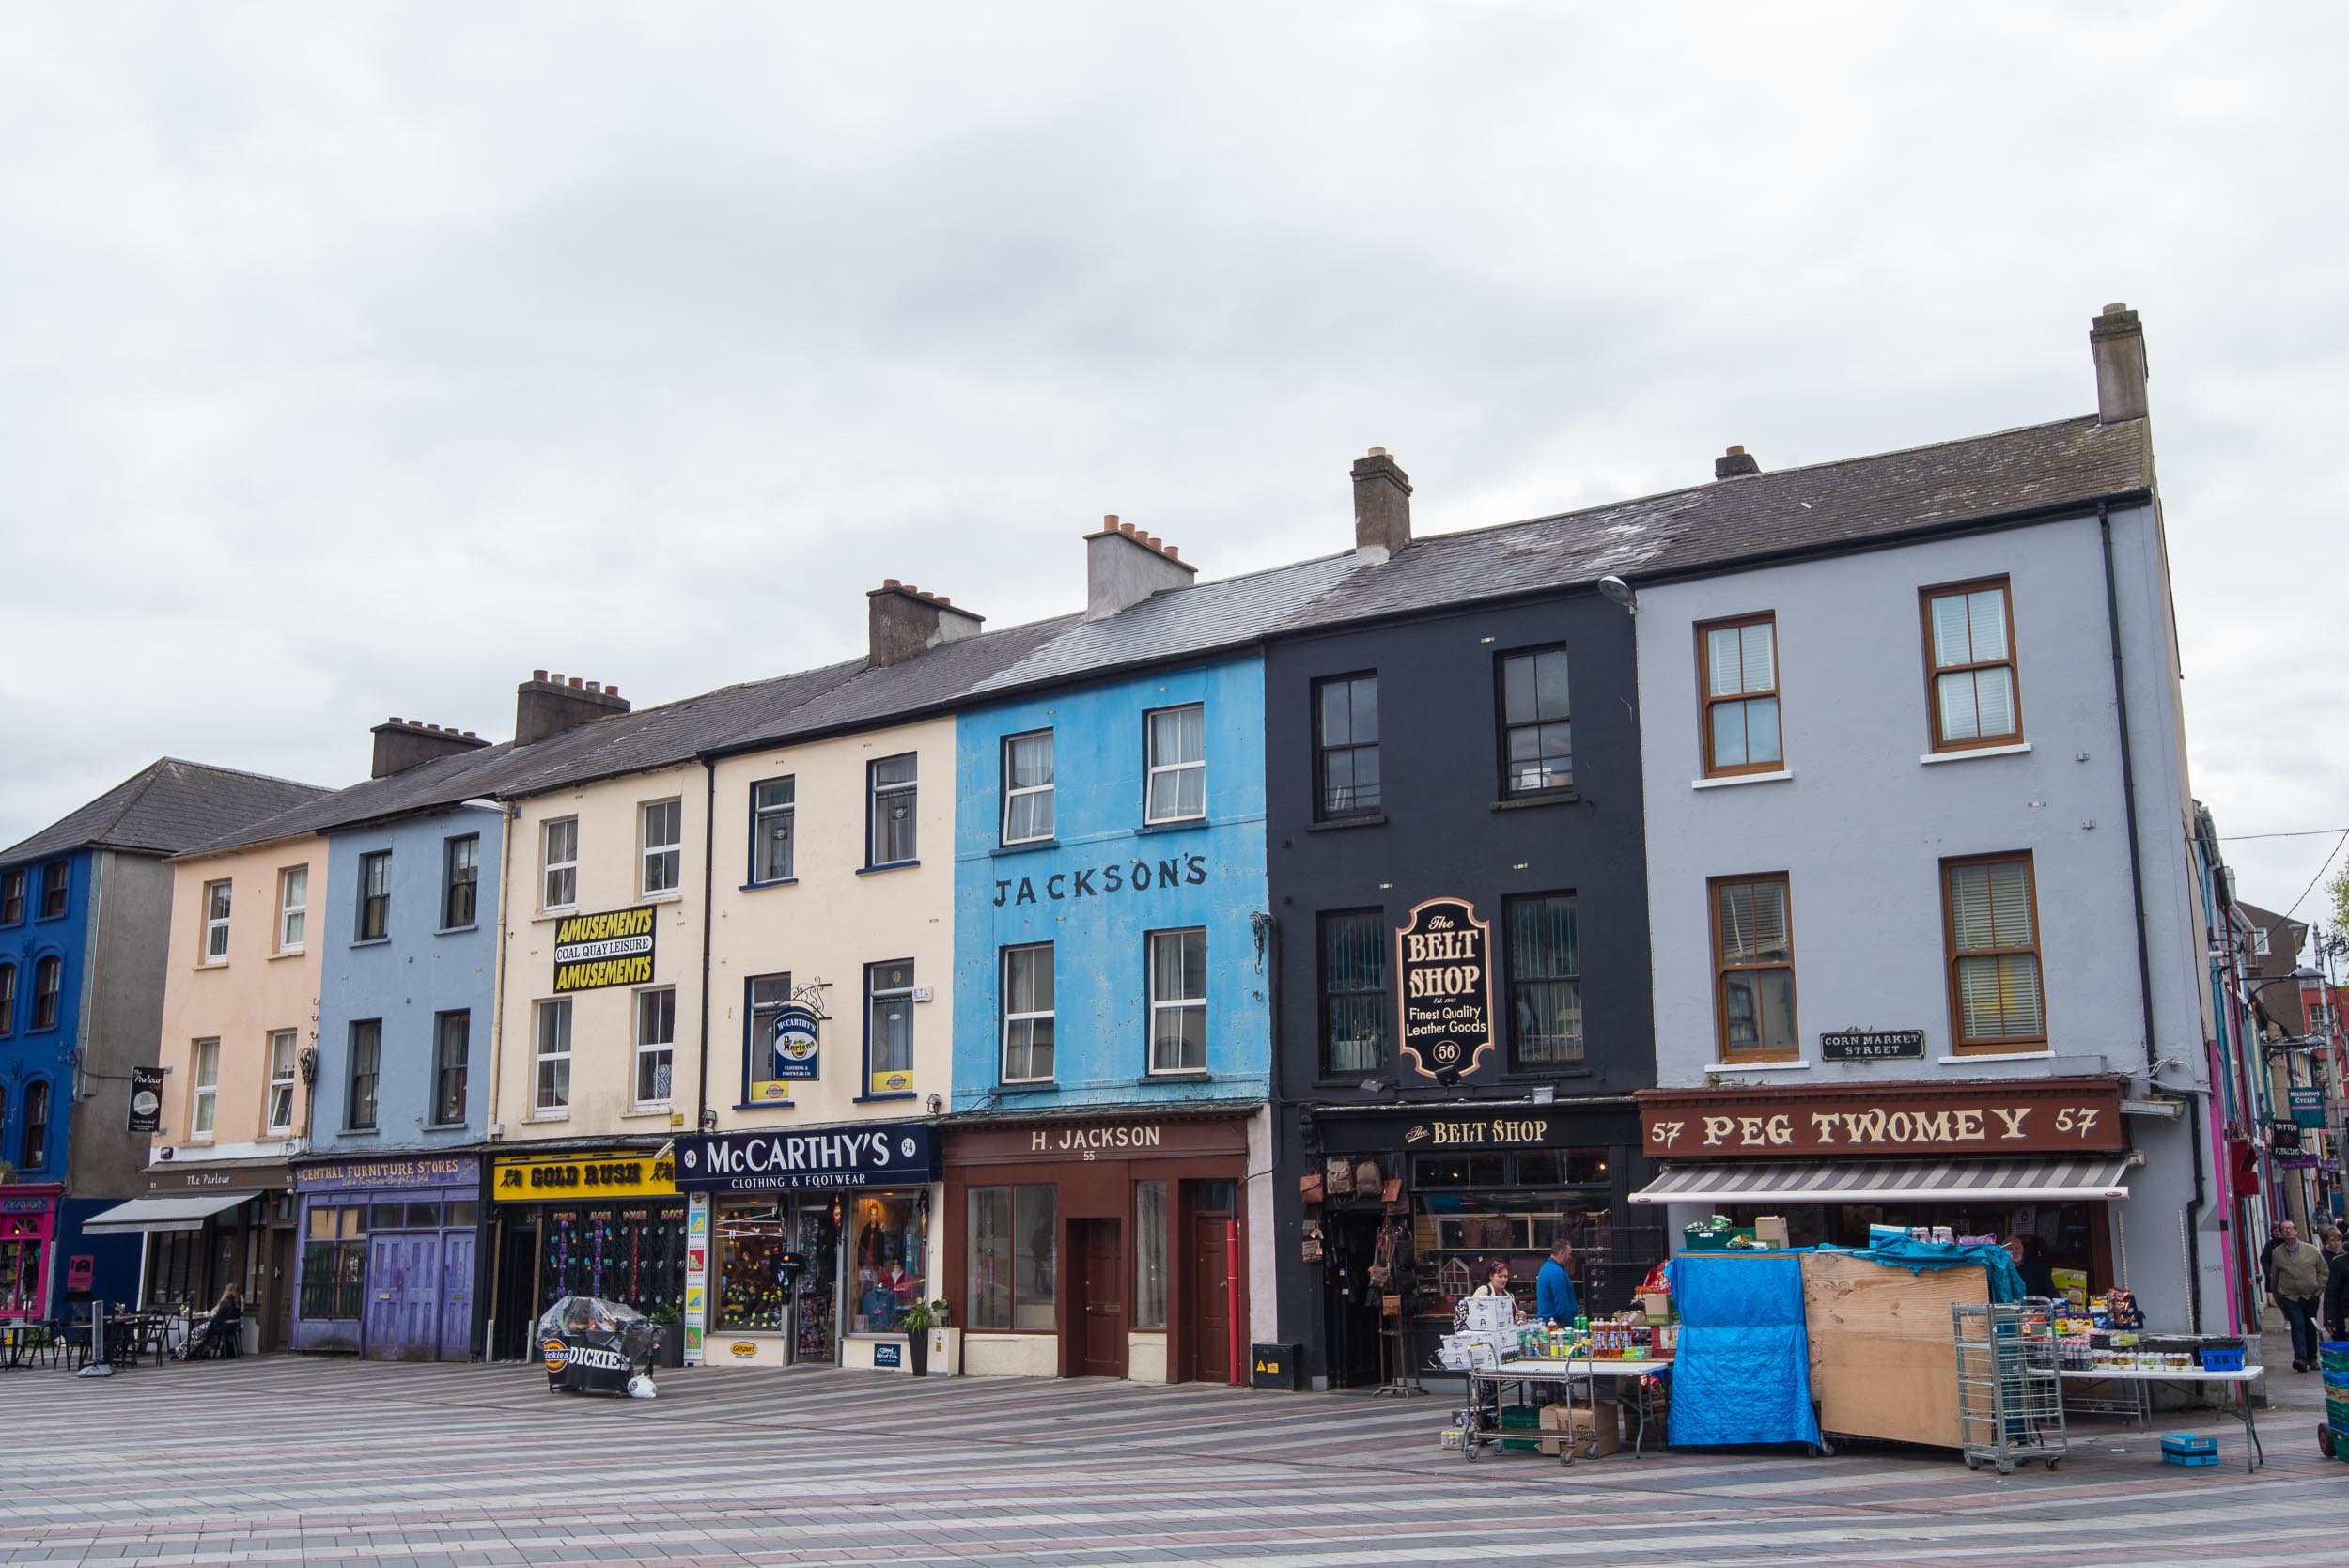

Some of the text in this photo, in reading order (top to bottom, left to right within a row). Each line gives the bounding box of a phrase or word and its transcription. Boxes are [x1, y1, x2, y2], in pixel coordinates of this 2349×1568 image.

[993, 852, 1207, 908] JACKSON'S
[556, 908, 653, 943] AMUSEMENTS
[1428, 916, 1455, 930] The
[557, 938, 649, 960] COAL QUAY LEISURE
[1408, 929, 1479, 963] BELT
[556, 956, 651, 990] AMUSEMENTS
[1409, 965, 1481, 999] SHOP
[1409, 1004, 1481, 1020] Finest Quality
[1406, 1019, 1486, 1036] Leather Goods
[1825, 1034, 1919, 1045] CORN MARKET
[1845, 1046, 1899, 1055] STREET
[1439, 1045, 1455, 1060] 56
[1406, 1119, 1548, 1144] The BELT SHOP
[1652, 1107, 2100, 1149] 57 PEG TWOMEY 57
[2275, 1123, 2297, 1131] TATTOO
[1032, 1126, 1160, 1151] H. JACKSON
[684, 1132, 914, 1173] 54 McCARTHY'S 54
[1083, 1151, 1095, 1161] 55
[187, 1175, 200, 1186] The
[203, 1172, 230, 1185] Parlour
[303, 1166, 344, 1181] CENTRAL
[347, 1162, 413, 1178] FURNITURE
[417, 1159, 459, 1173] STORES
[531, 1162, 642, 1187] GOLD RUSH
[731, 1174, 865, 1189] CLOTHING & FOOTWEAR
[545, 1346, 630, 1371] ickies DICKIES
